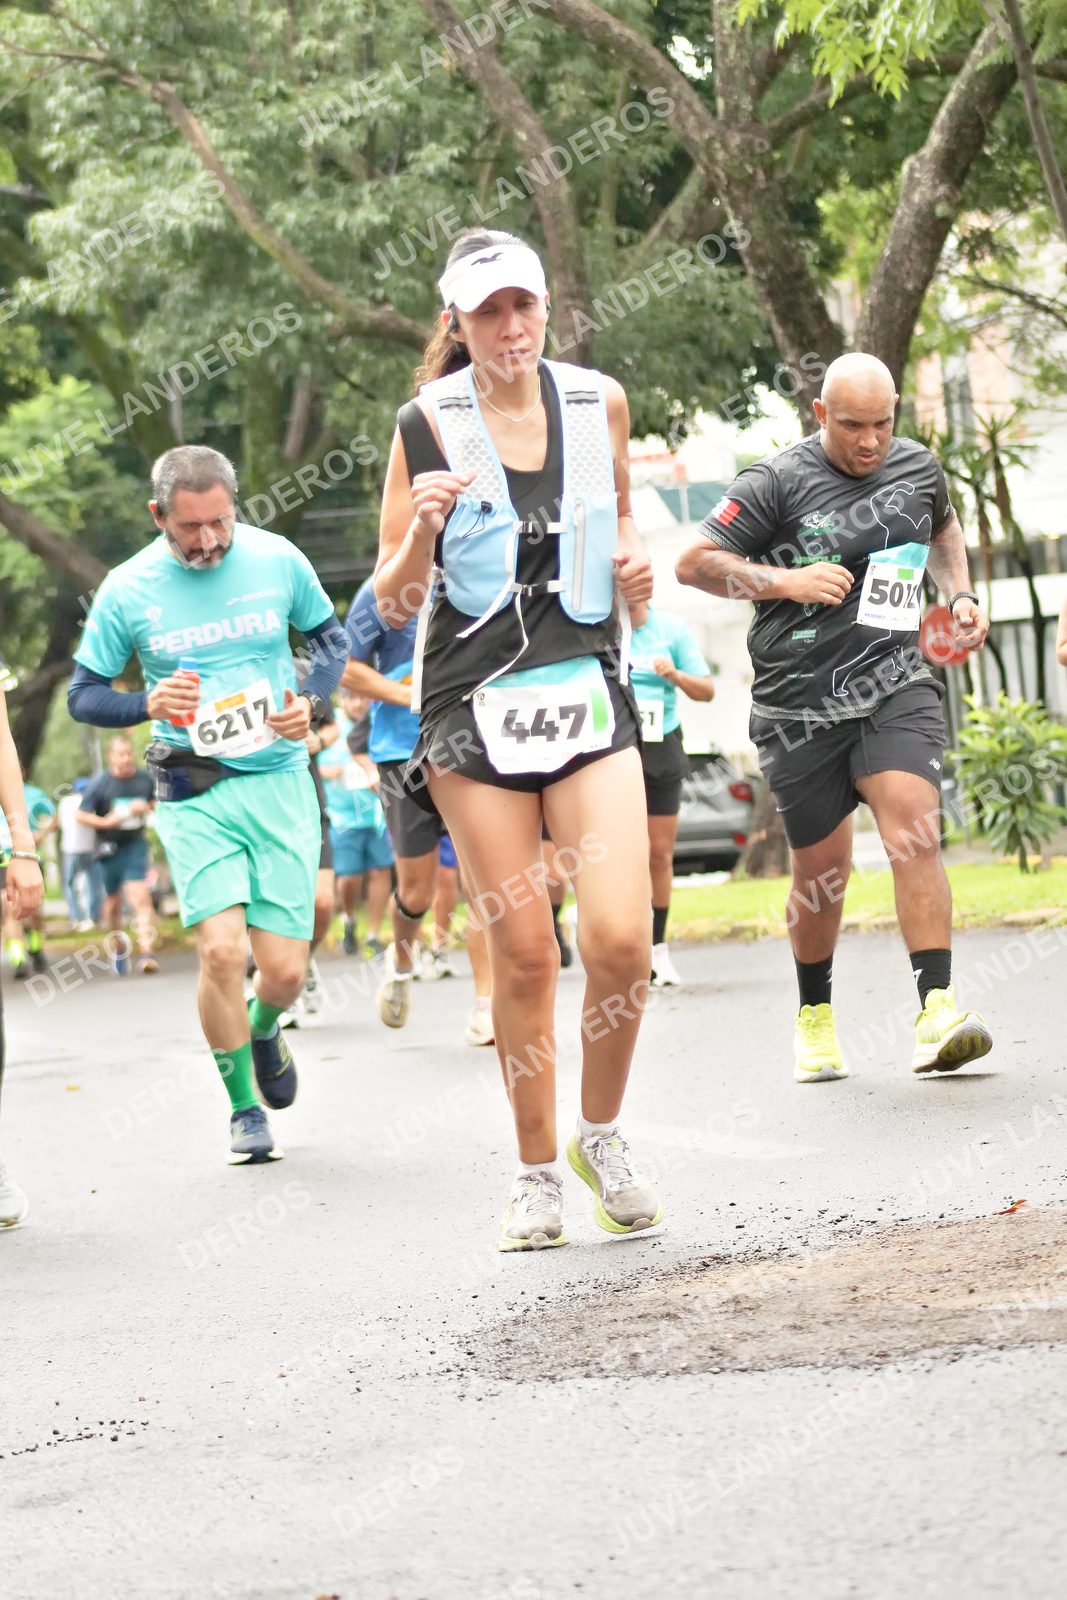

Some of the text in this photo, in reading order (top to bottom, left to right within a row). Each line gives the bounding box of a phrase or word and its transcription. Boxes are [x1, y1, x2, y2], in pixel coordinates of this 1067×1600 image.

[148, 608, 281, 656] PERDURA
[198, 697, 269, 745] 6217
[501, 703, 587, 744] 447
